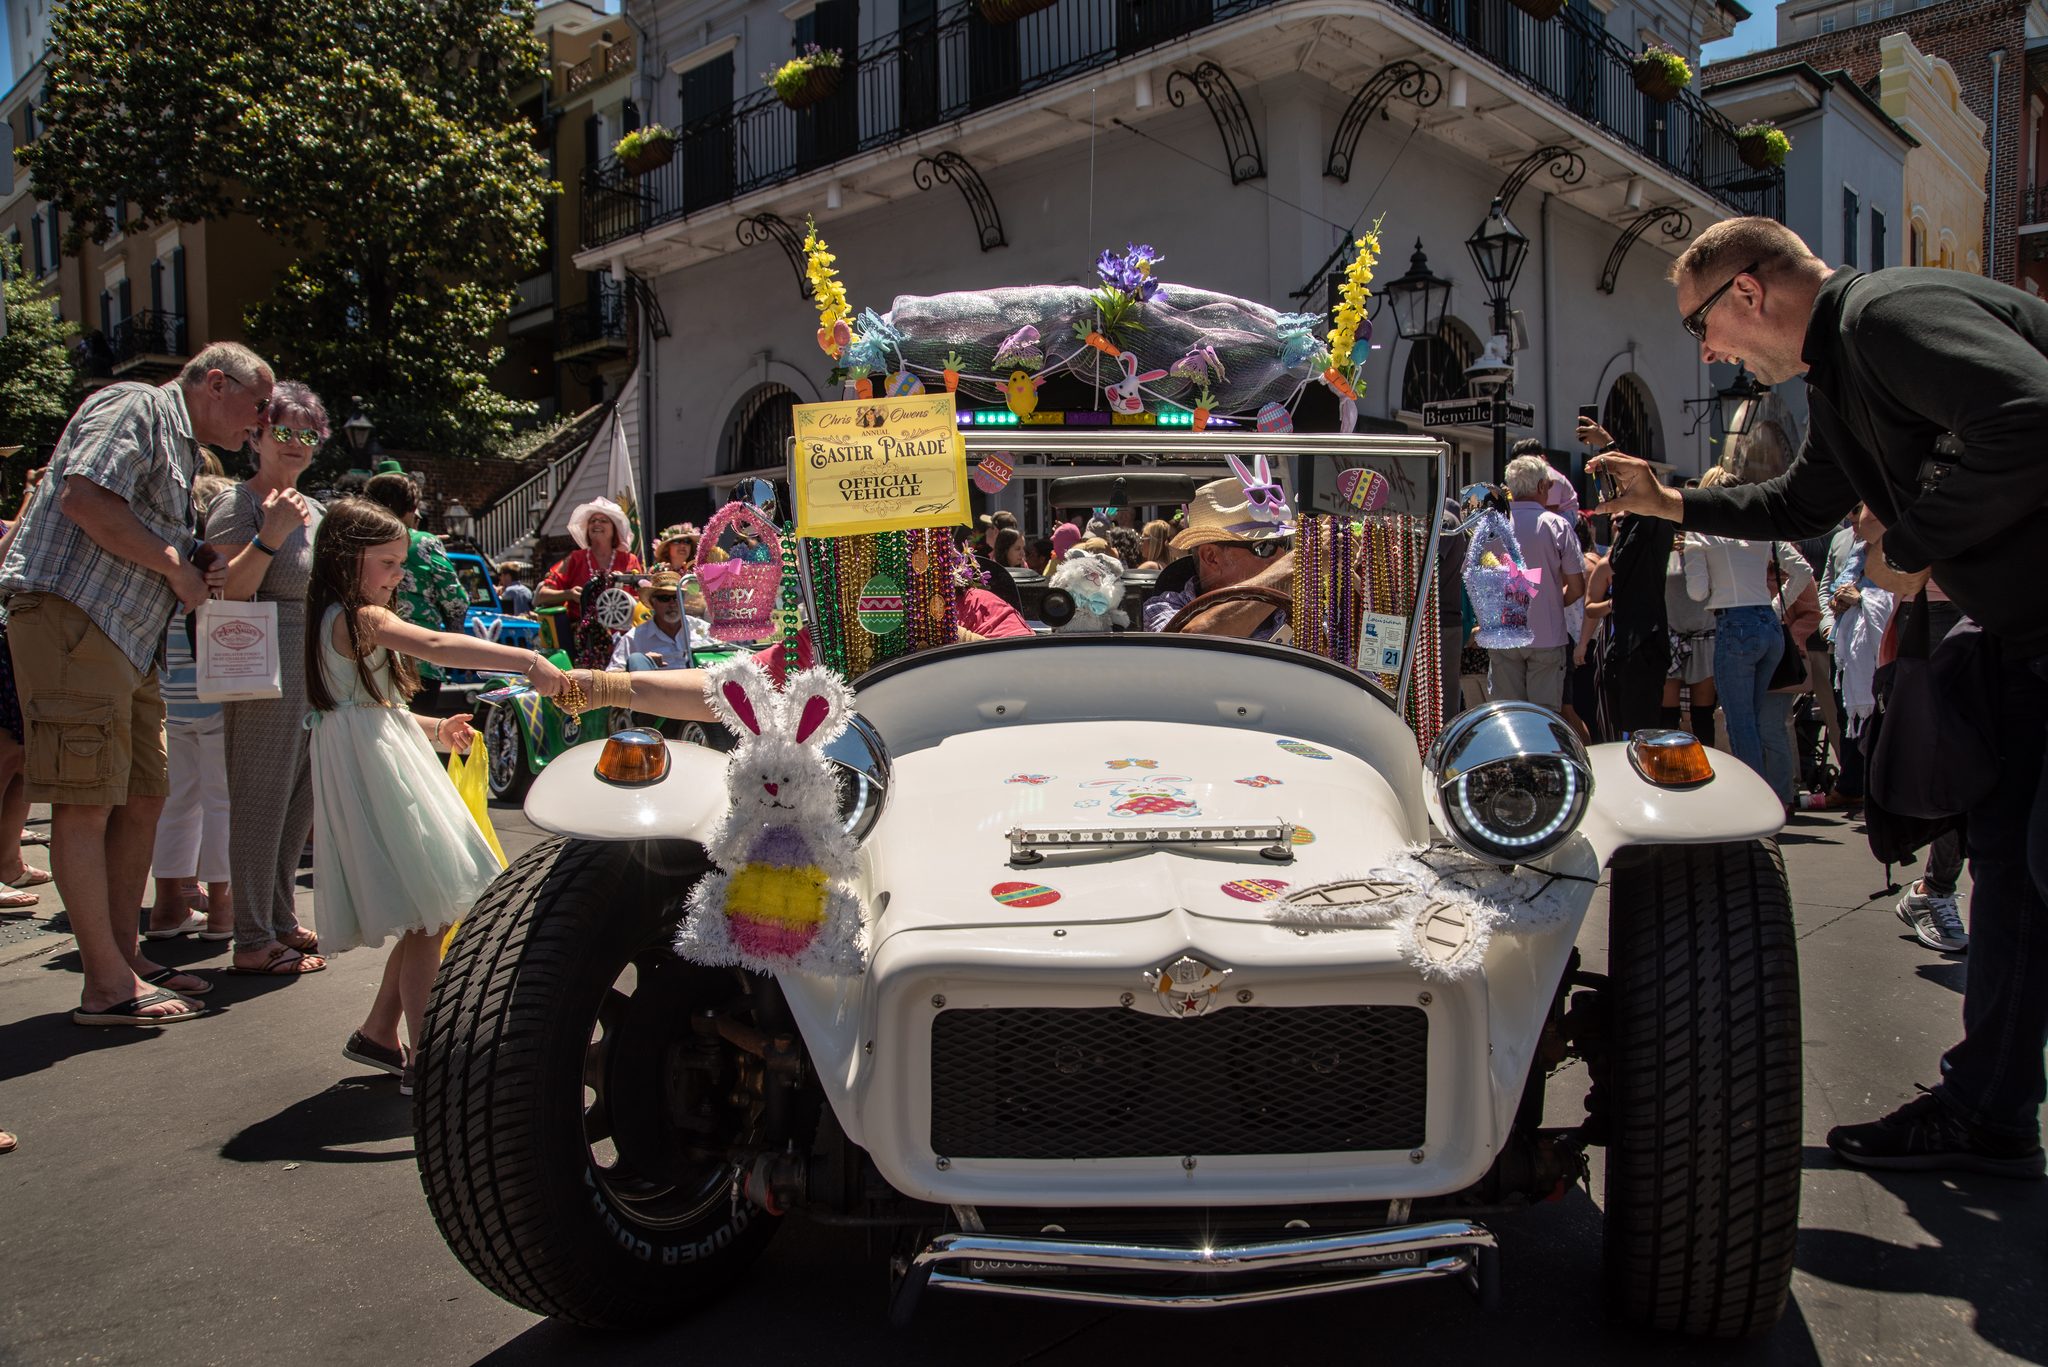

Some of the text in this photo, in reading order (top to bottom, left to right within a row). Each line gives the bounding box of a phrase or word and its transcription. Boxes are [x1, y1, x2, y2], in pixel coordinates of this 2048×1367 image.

[818, 407, 929, 429] Chris Owens
[1425, 407, 1490, 424] Bienville
[861, 428, 891, 437] ANNUAL
[810, 435, 947, 469] EASTER PARADE
[838, 473, 923, 490] OFFICIAL
[840, 484, 922, 502] VEHICLE
[1384, 651, 1398, 666] 21
[662, 1198, 757, 1266] OOPER
